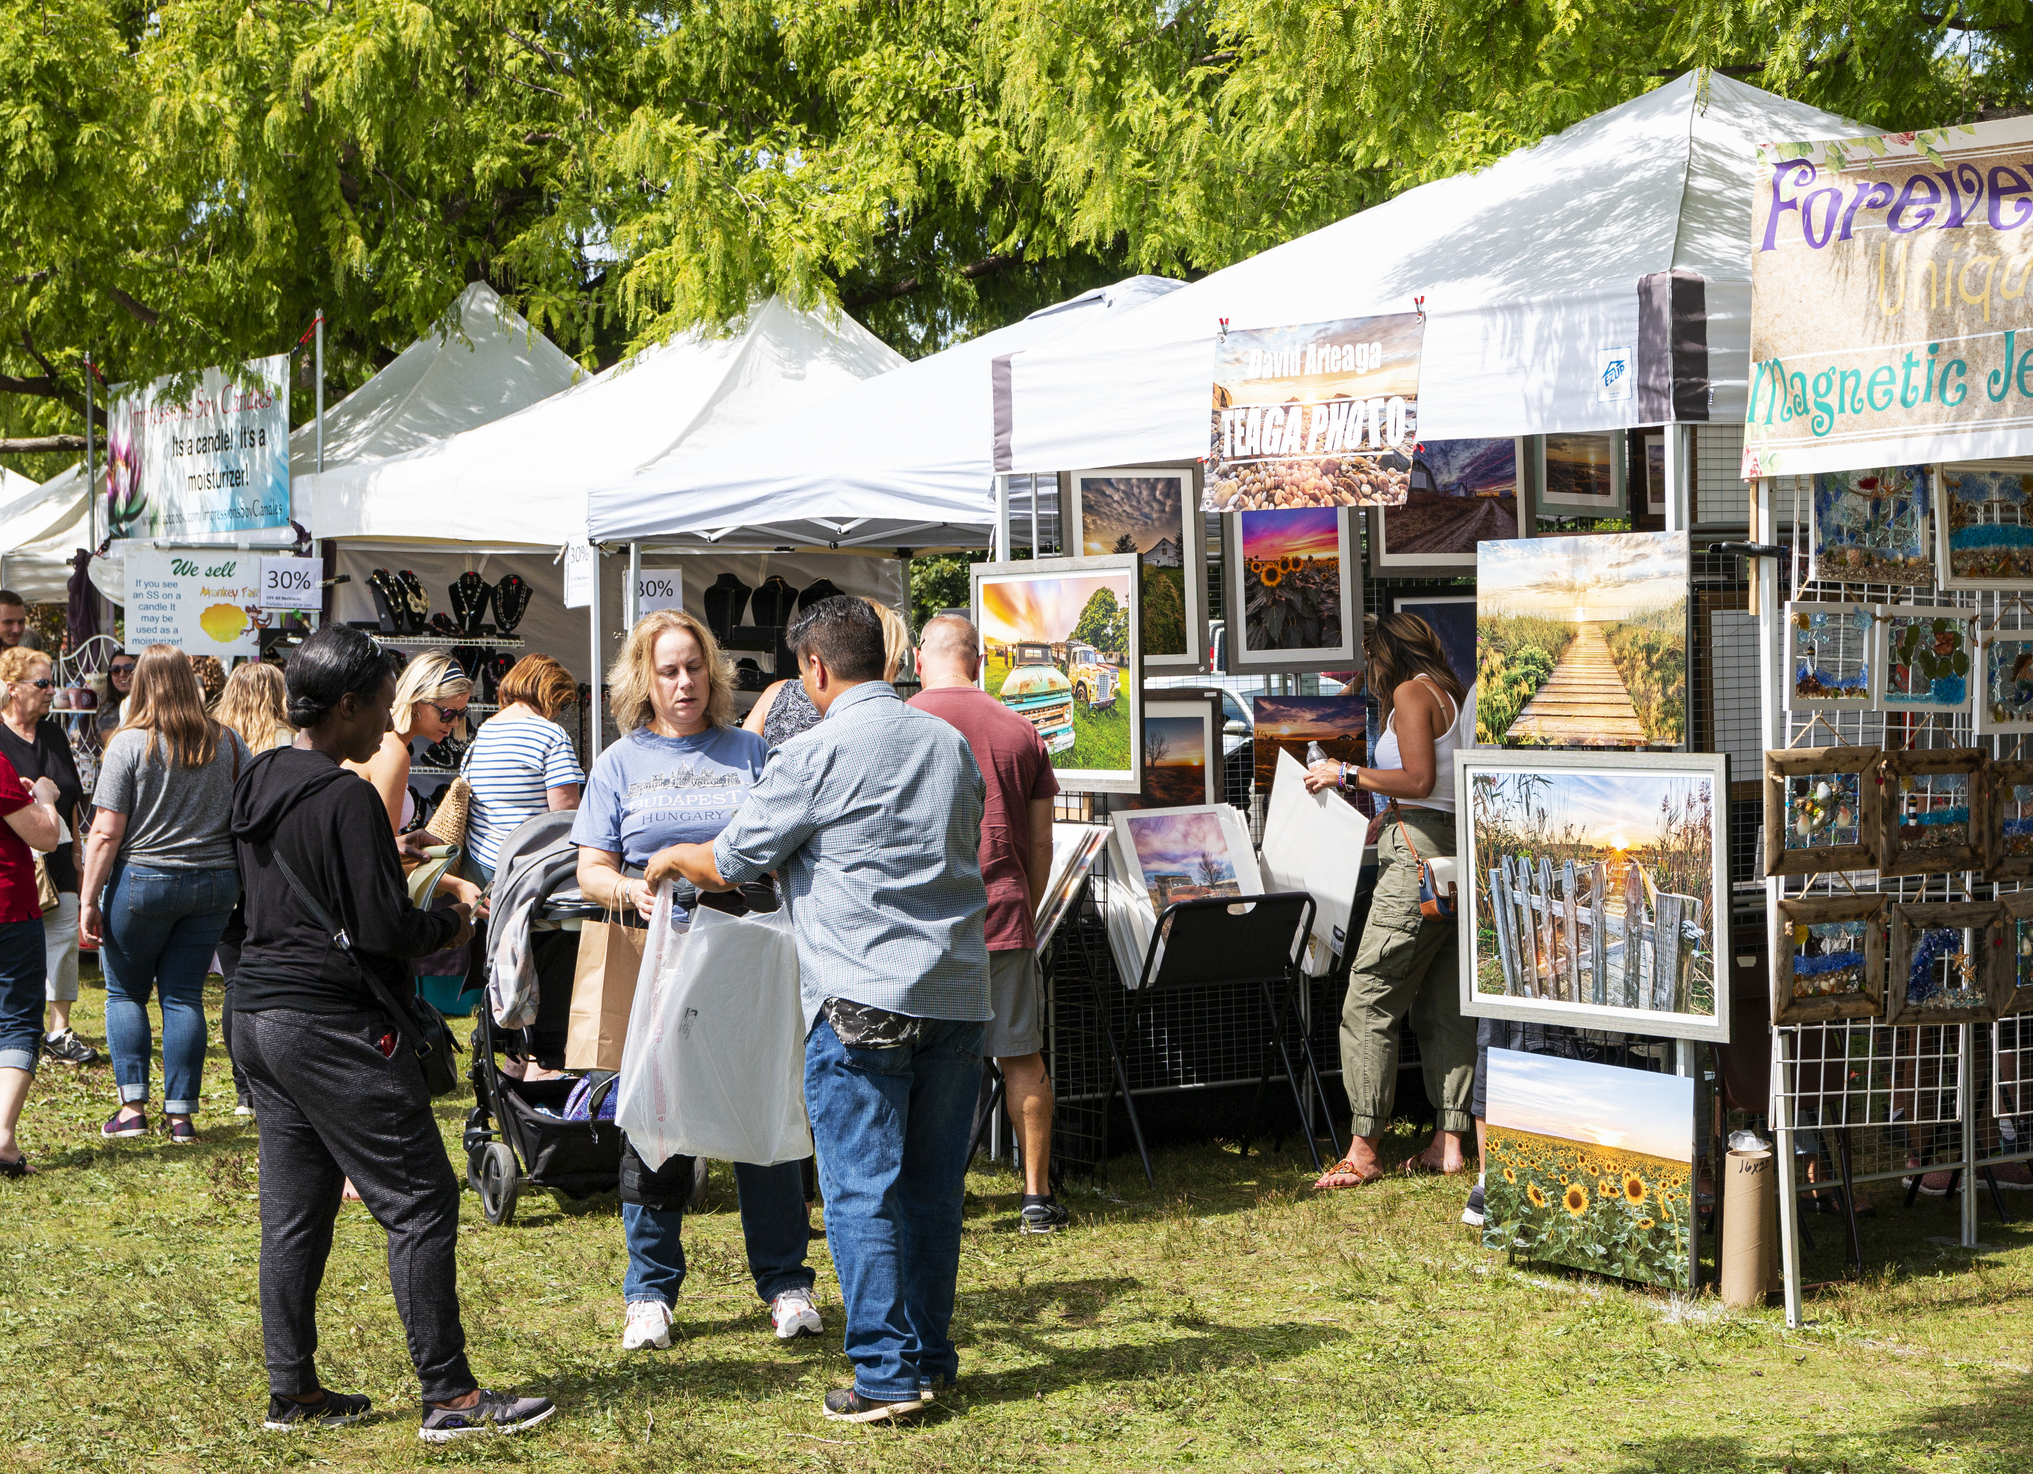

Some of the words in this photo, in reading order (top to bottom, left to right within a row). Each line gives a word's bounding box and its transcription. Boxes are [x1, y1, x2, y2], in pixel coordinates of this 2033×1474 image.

[1248, 344, 1301, 380] David
[1304, 341, 1383, 375] Arteaga
[1747, 343, 1968, 437] Magnetic
[196, 388, 218, 421] Soy
[221, 384, 272, 414] Candles
[1221, 405, 1303, 458] TEAGA
[1306, 396, 1407, 453] PHOTO
[172, 435, 184, 457] Its
[187, 442, 193, 456] a
[196, 428, 233, 454] candle!
[240, 425, 255, 449] It's
[259, 428, 266, 447] a
[188, 462, 249, 492] moisturizer!
[570, 545, 590, 564] 30%
[171, 558, 200, 577] We
[205, 561, 237, 578] sell
[135, 579, 142, 587] If
[143, 581, 160, 590] you
[162, 581, 179, 589] see
[267, 570, 311, 590] 30%
[146, 590, 160, 600] SS
[162, 592, 174, 600] on
[175, 592, 182, 600] a
[199, 585, 239, 603] Monkey
[138, 602, 168, 611] candle
[170, 603, 176, 611] It
[141, 615, 160, 624] may
[162, 614, 174, 623] be
[135, 626, 158, 634] used
[131, 637, 183, 646] moisturizer!
[629, 789, 743, 811] BUDAPEST
[642, 810, 725, 825] HUNGARY
